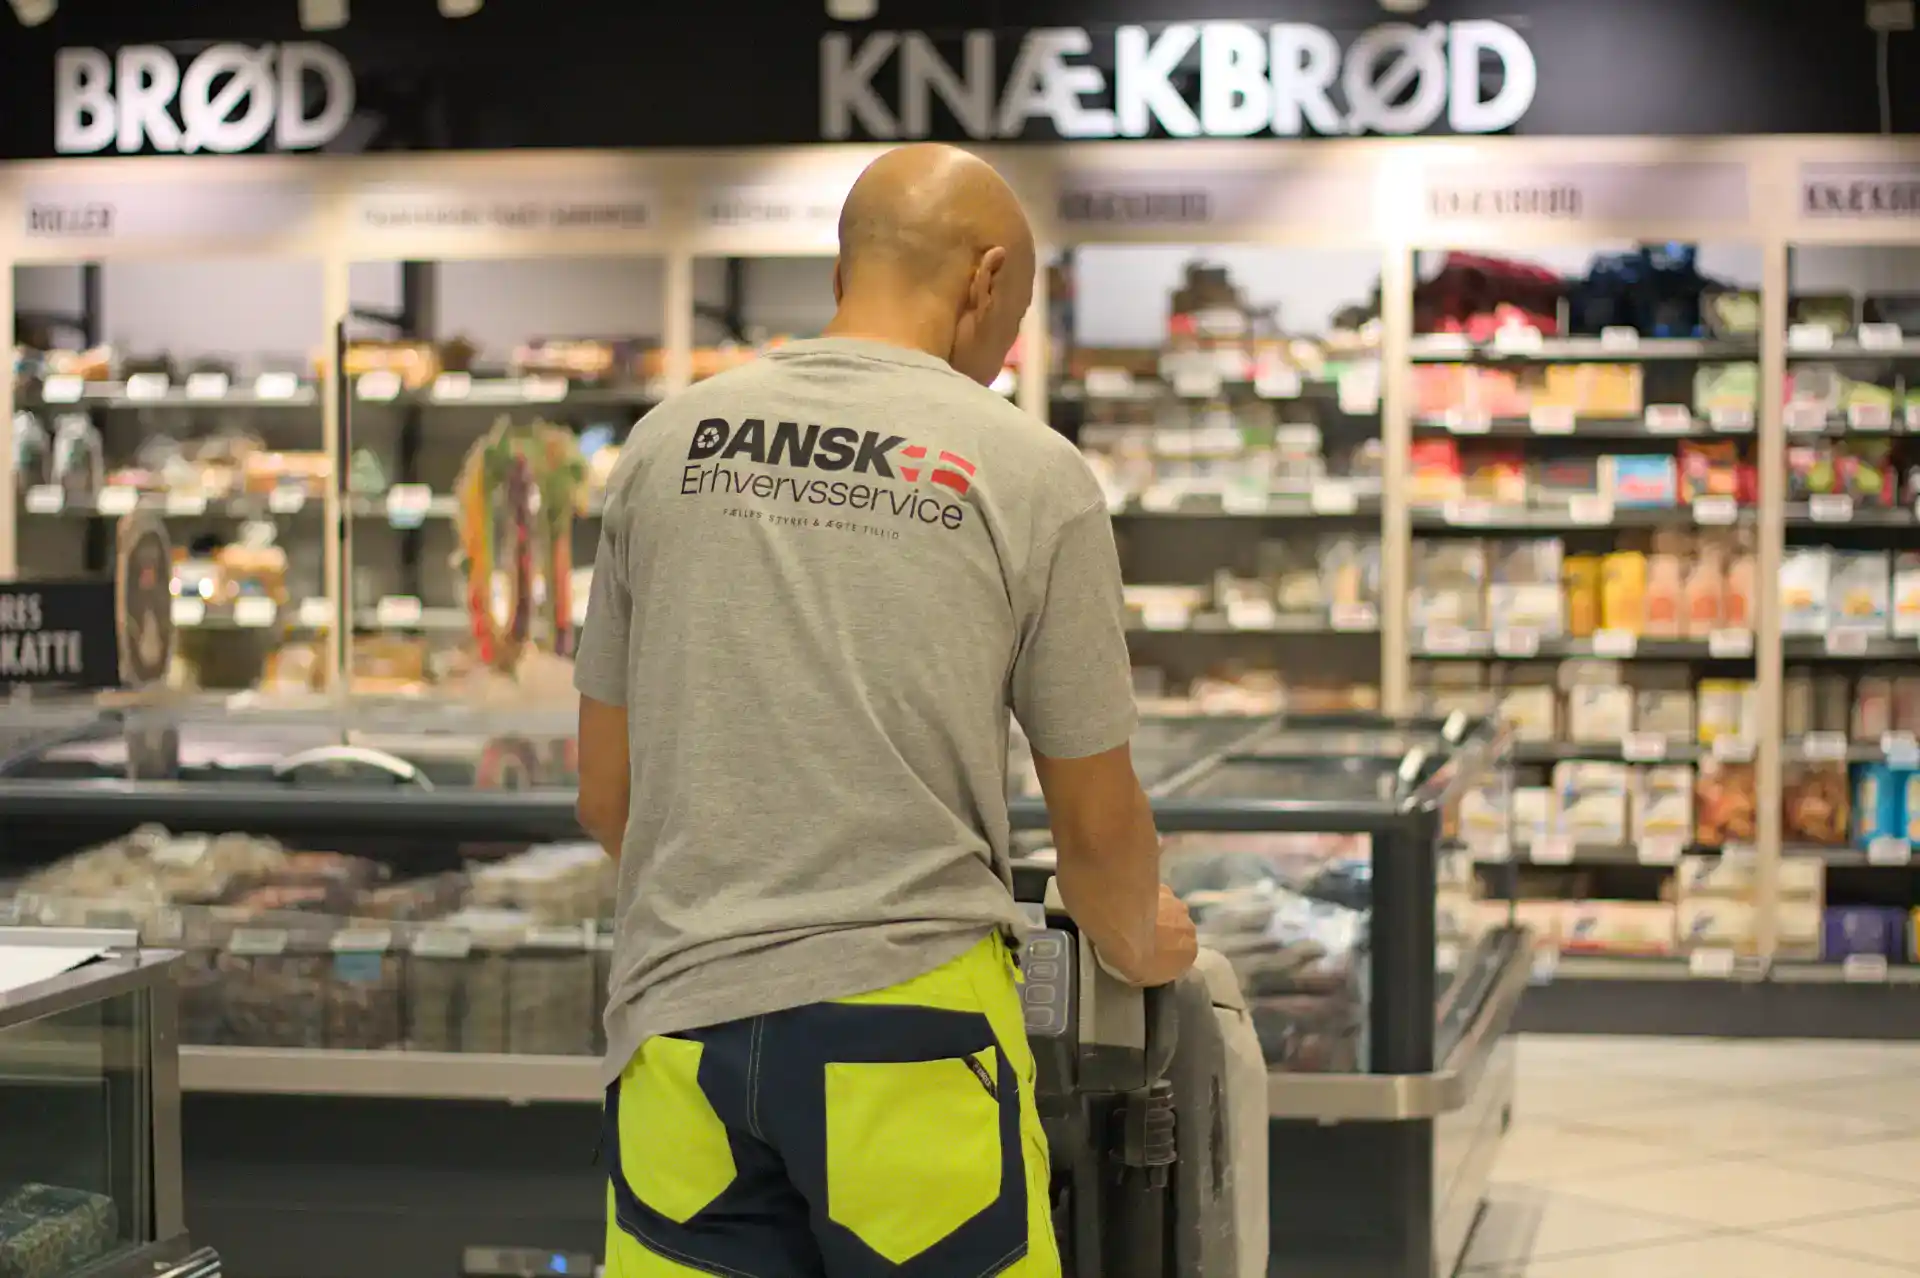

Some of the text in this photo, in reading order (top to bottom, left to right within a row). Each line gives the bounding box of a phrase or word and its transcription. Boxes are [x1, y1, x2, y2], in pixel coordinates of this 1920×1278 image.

[54, 42, 356, 154] BRØD
[819, 20, 1537, 138] KNÆKBRØD
[687, 418, 907, 479] DANSK
[681, 463, 963, 530] Erhvervsservice
[825, 520, 857, 532] ÆGTE
[863, 525, 900, 541] TILLID
